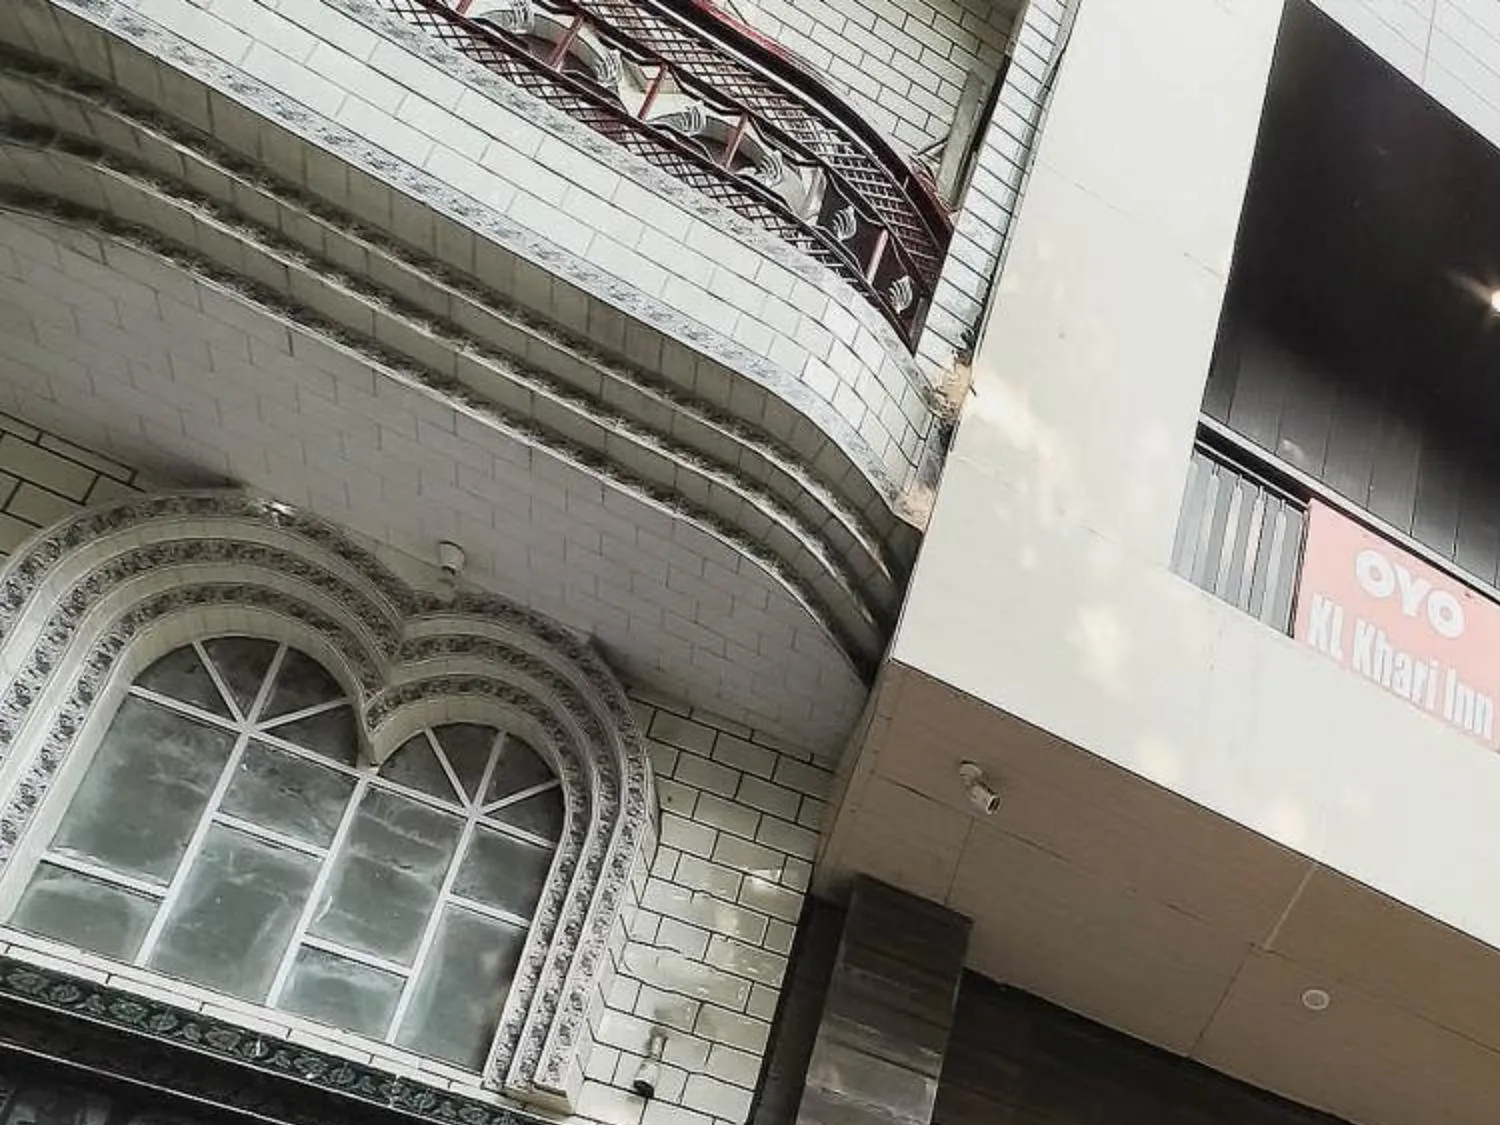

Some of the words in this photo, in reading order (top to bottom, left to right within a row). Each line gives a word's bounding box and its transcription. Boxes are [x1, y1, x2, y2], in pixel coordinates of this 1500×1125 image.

[1355, 549, 1466, 639] OYO
[1308, 590, 1344, 662] KL
[1352, 616, 1439, 712] Khari
[1443, 666, 1494, 741] Inn
